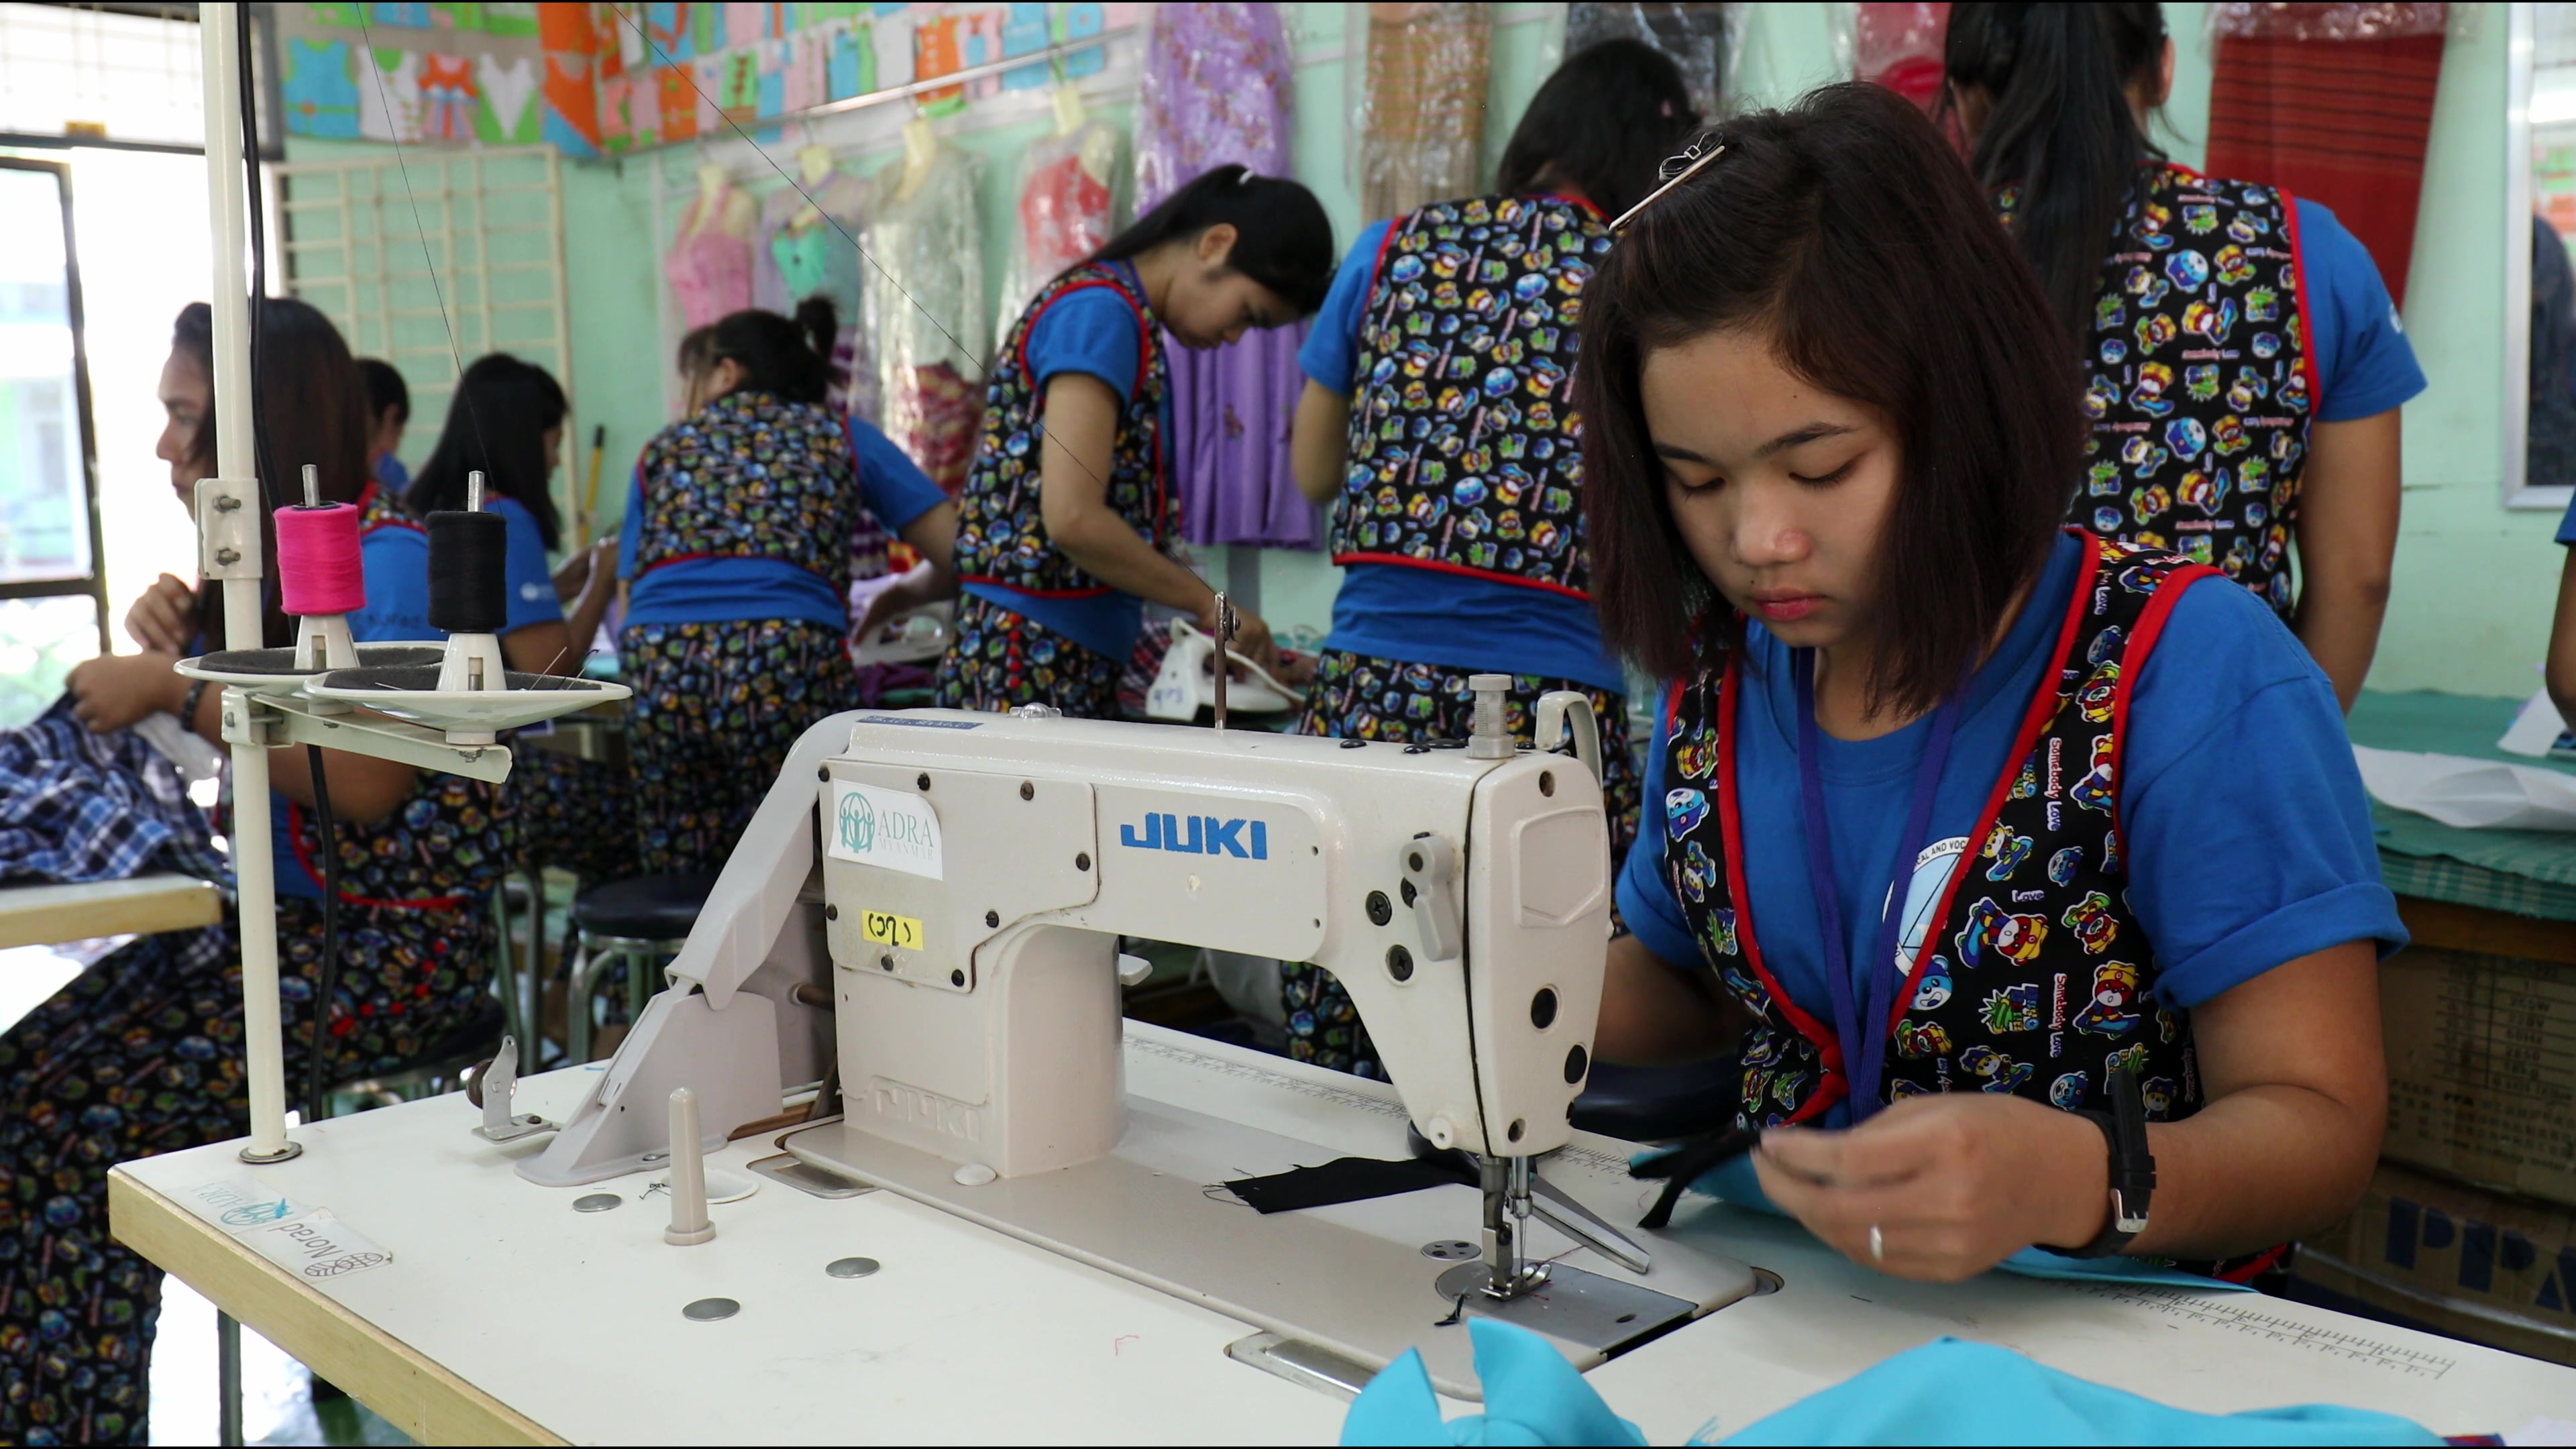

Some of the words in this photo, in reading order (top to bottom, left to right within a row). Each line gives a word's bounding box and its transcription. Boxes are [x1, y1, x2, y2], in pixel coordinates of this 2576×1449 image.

[2094, 586, 2111, 615] Love
[2044, 737, 2063, 799] Somebody
[878, 810, 934, 848] ADRA
[2047, 802, 2063, 831] Love
[879, 838, 933, 861] MYANMAR
[1120, 812, 1267, 861] JUKI
[1931, 843, 1947, 855] AND
[2012, 889, 2045, 903] Love
[2048, 972, 2068, 1032] Somebody
[2049, 1032, 2063, 1058] Love
[267, 1222, 343, 1259] Norad
